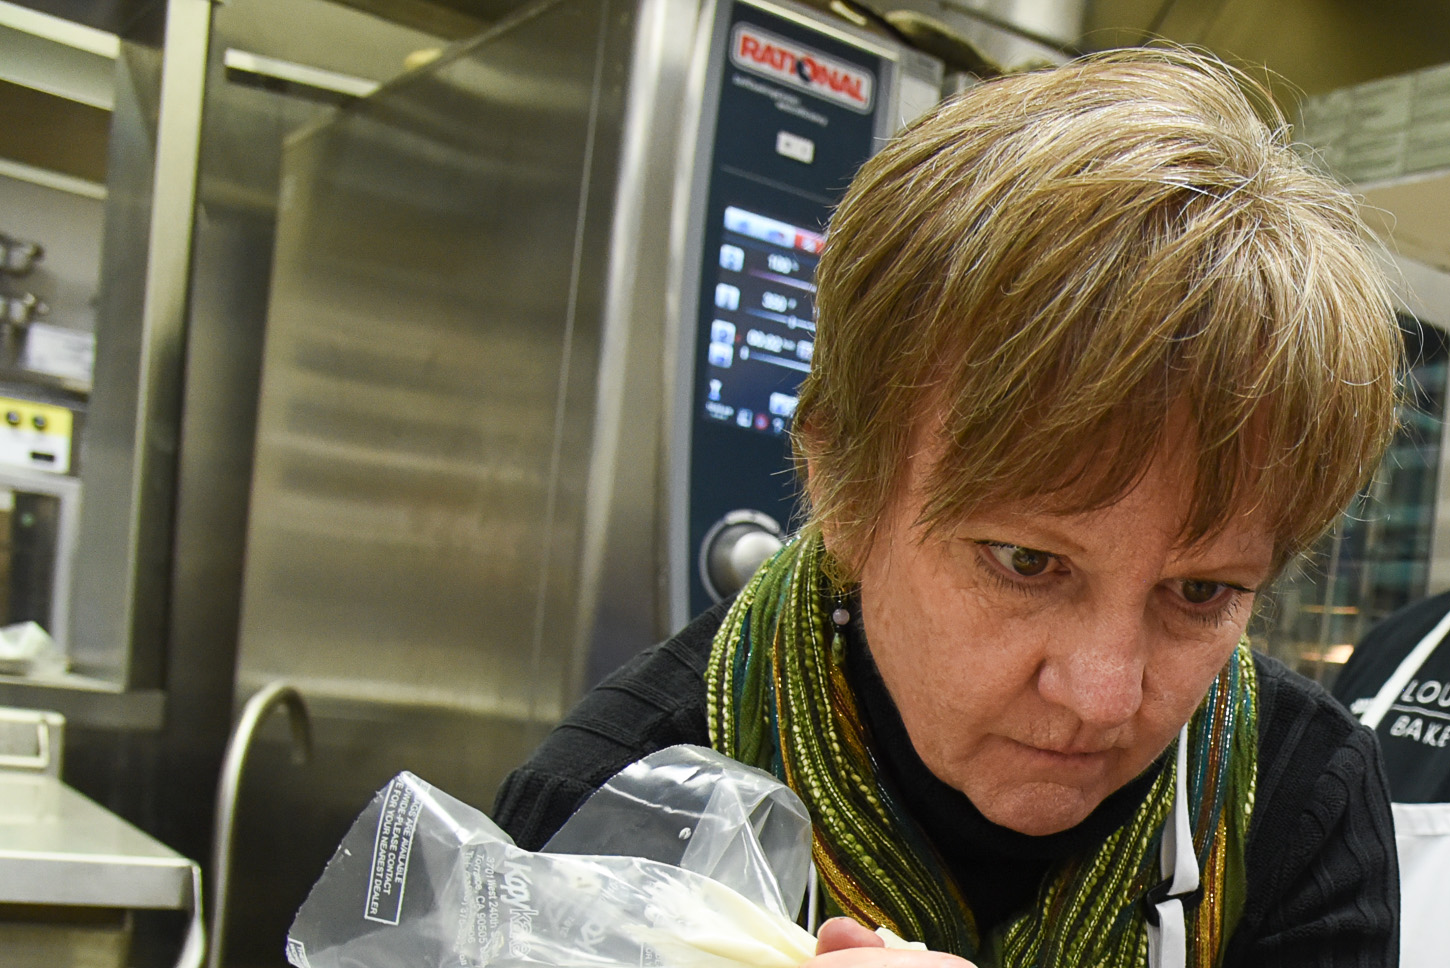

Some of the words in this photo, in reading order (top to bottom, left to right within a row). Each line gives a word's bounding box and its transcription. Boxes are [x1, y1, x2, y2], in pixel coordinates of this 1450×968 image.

[740, 34, 868, 103] RATIONAL
[389, 789, 402, 809] FOR
[381, 810, 396, 836] YOUR
[402, 817, 414, 837] ARE
[375, 836, 390, 879] NEAREST
[394, 836, 411, 884] AVAILABLE
[485, 856, 495, 879] 3701
[382, 852, 396, 895] CONTACT
[369, 878, 383, 915] DEALER
[476, 895, 486, 911] CA
[486, 879, 497, 900] West
[477, 912, 487, 944] 90505
[488, 901, 499, 929] 240th
